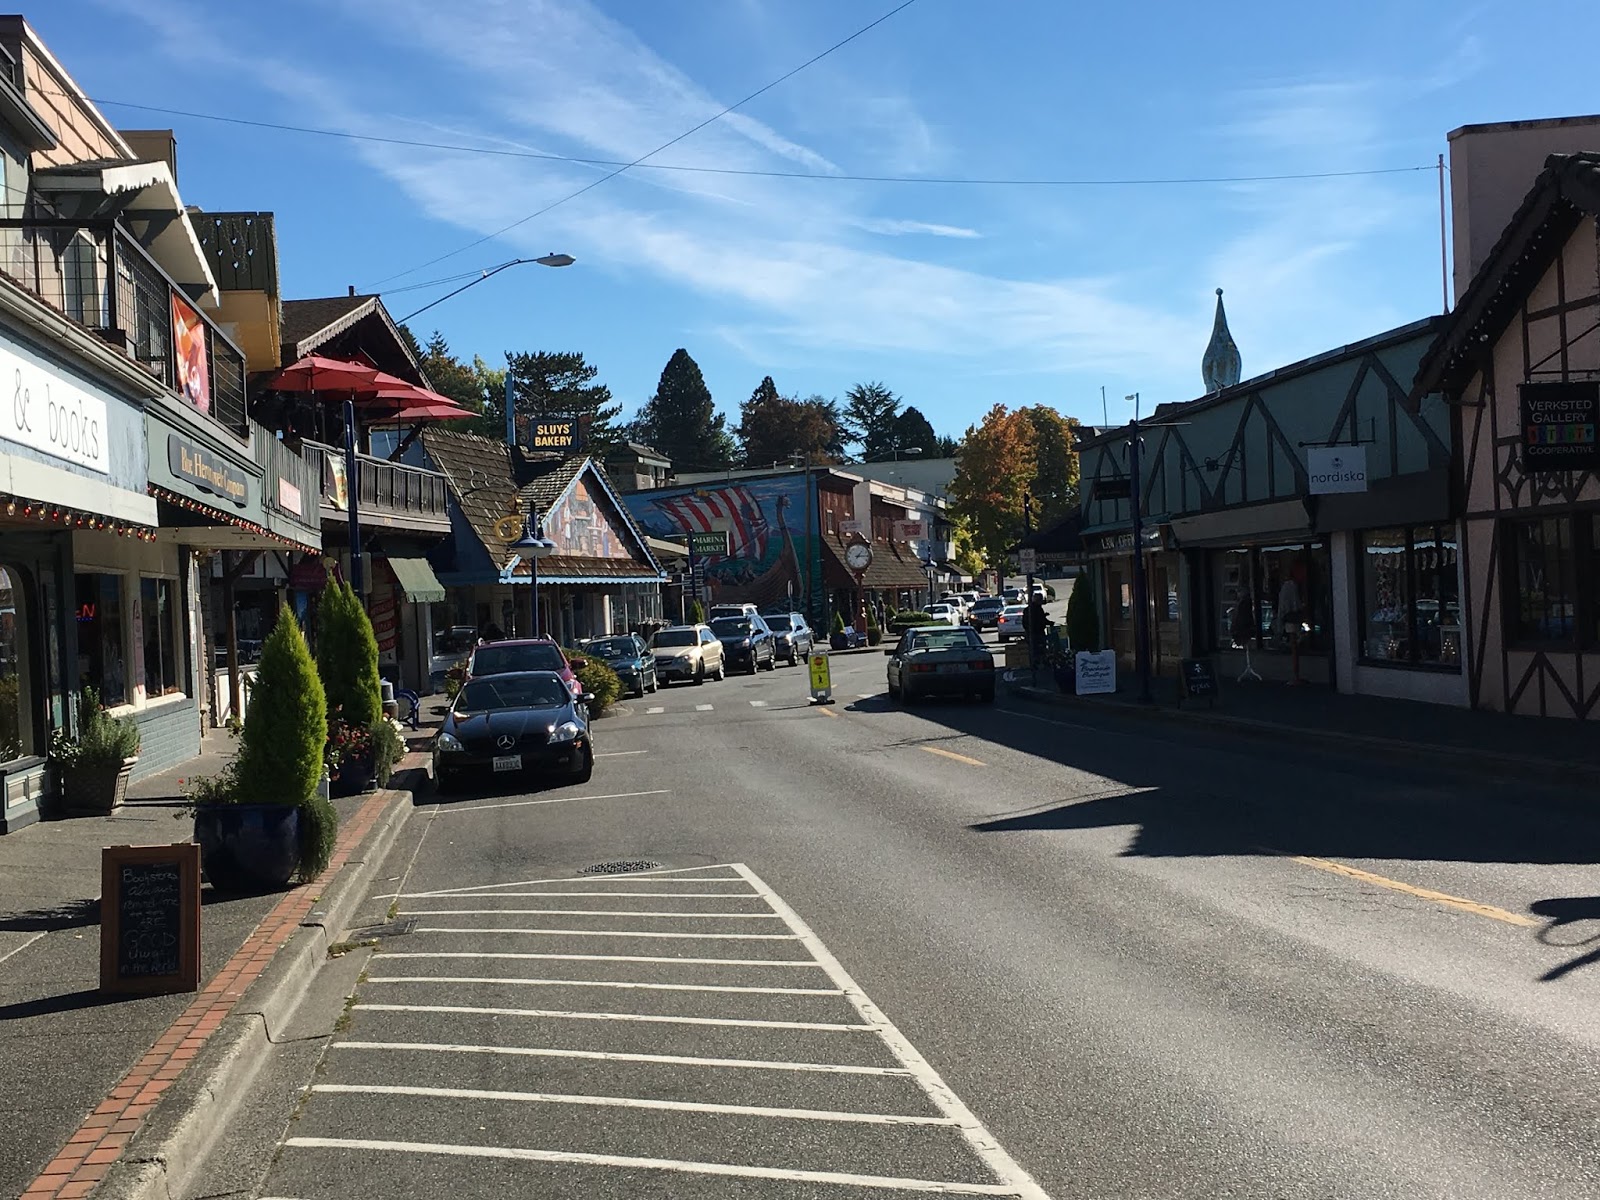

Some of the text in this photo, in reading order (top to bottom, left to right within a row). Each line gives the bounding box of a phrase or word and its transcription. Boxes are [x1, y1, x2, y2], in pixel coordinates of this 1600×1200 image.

[1528, 400, 1593, 411] VERKSTED
[13, 368, 99, 460] & books
[1531, 412, 1587, 423] GALLERY
[535, 435, 573, 447] BAKERY
[1528, 445, 1595, 455] COOPERATIVE
[1310, 470, 1365, 483] nordiska
[695, 536, 725, 544] MARINA
[695, 544, 726, 553] MARKET
